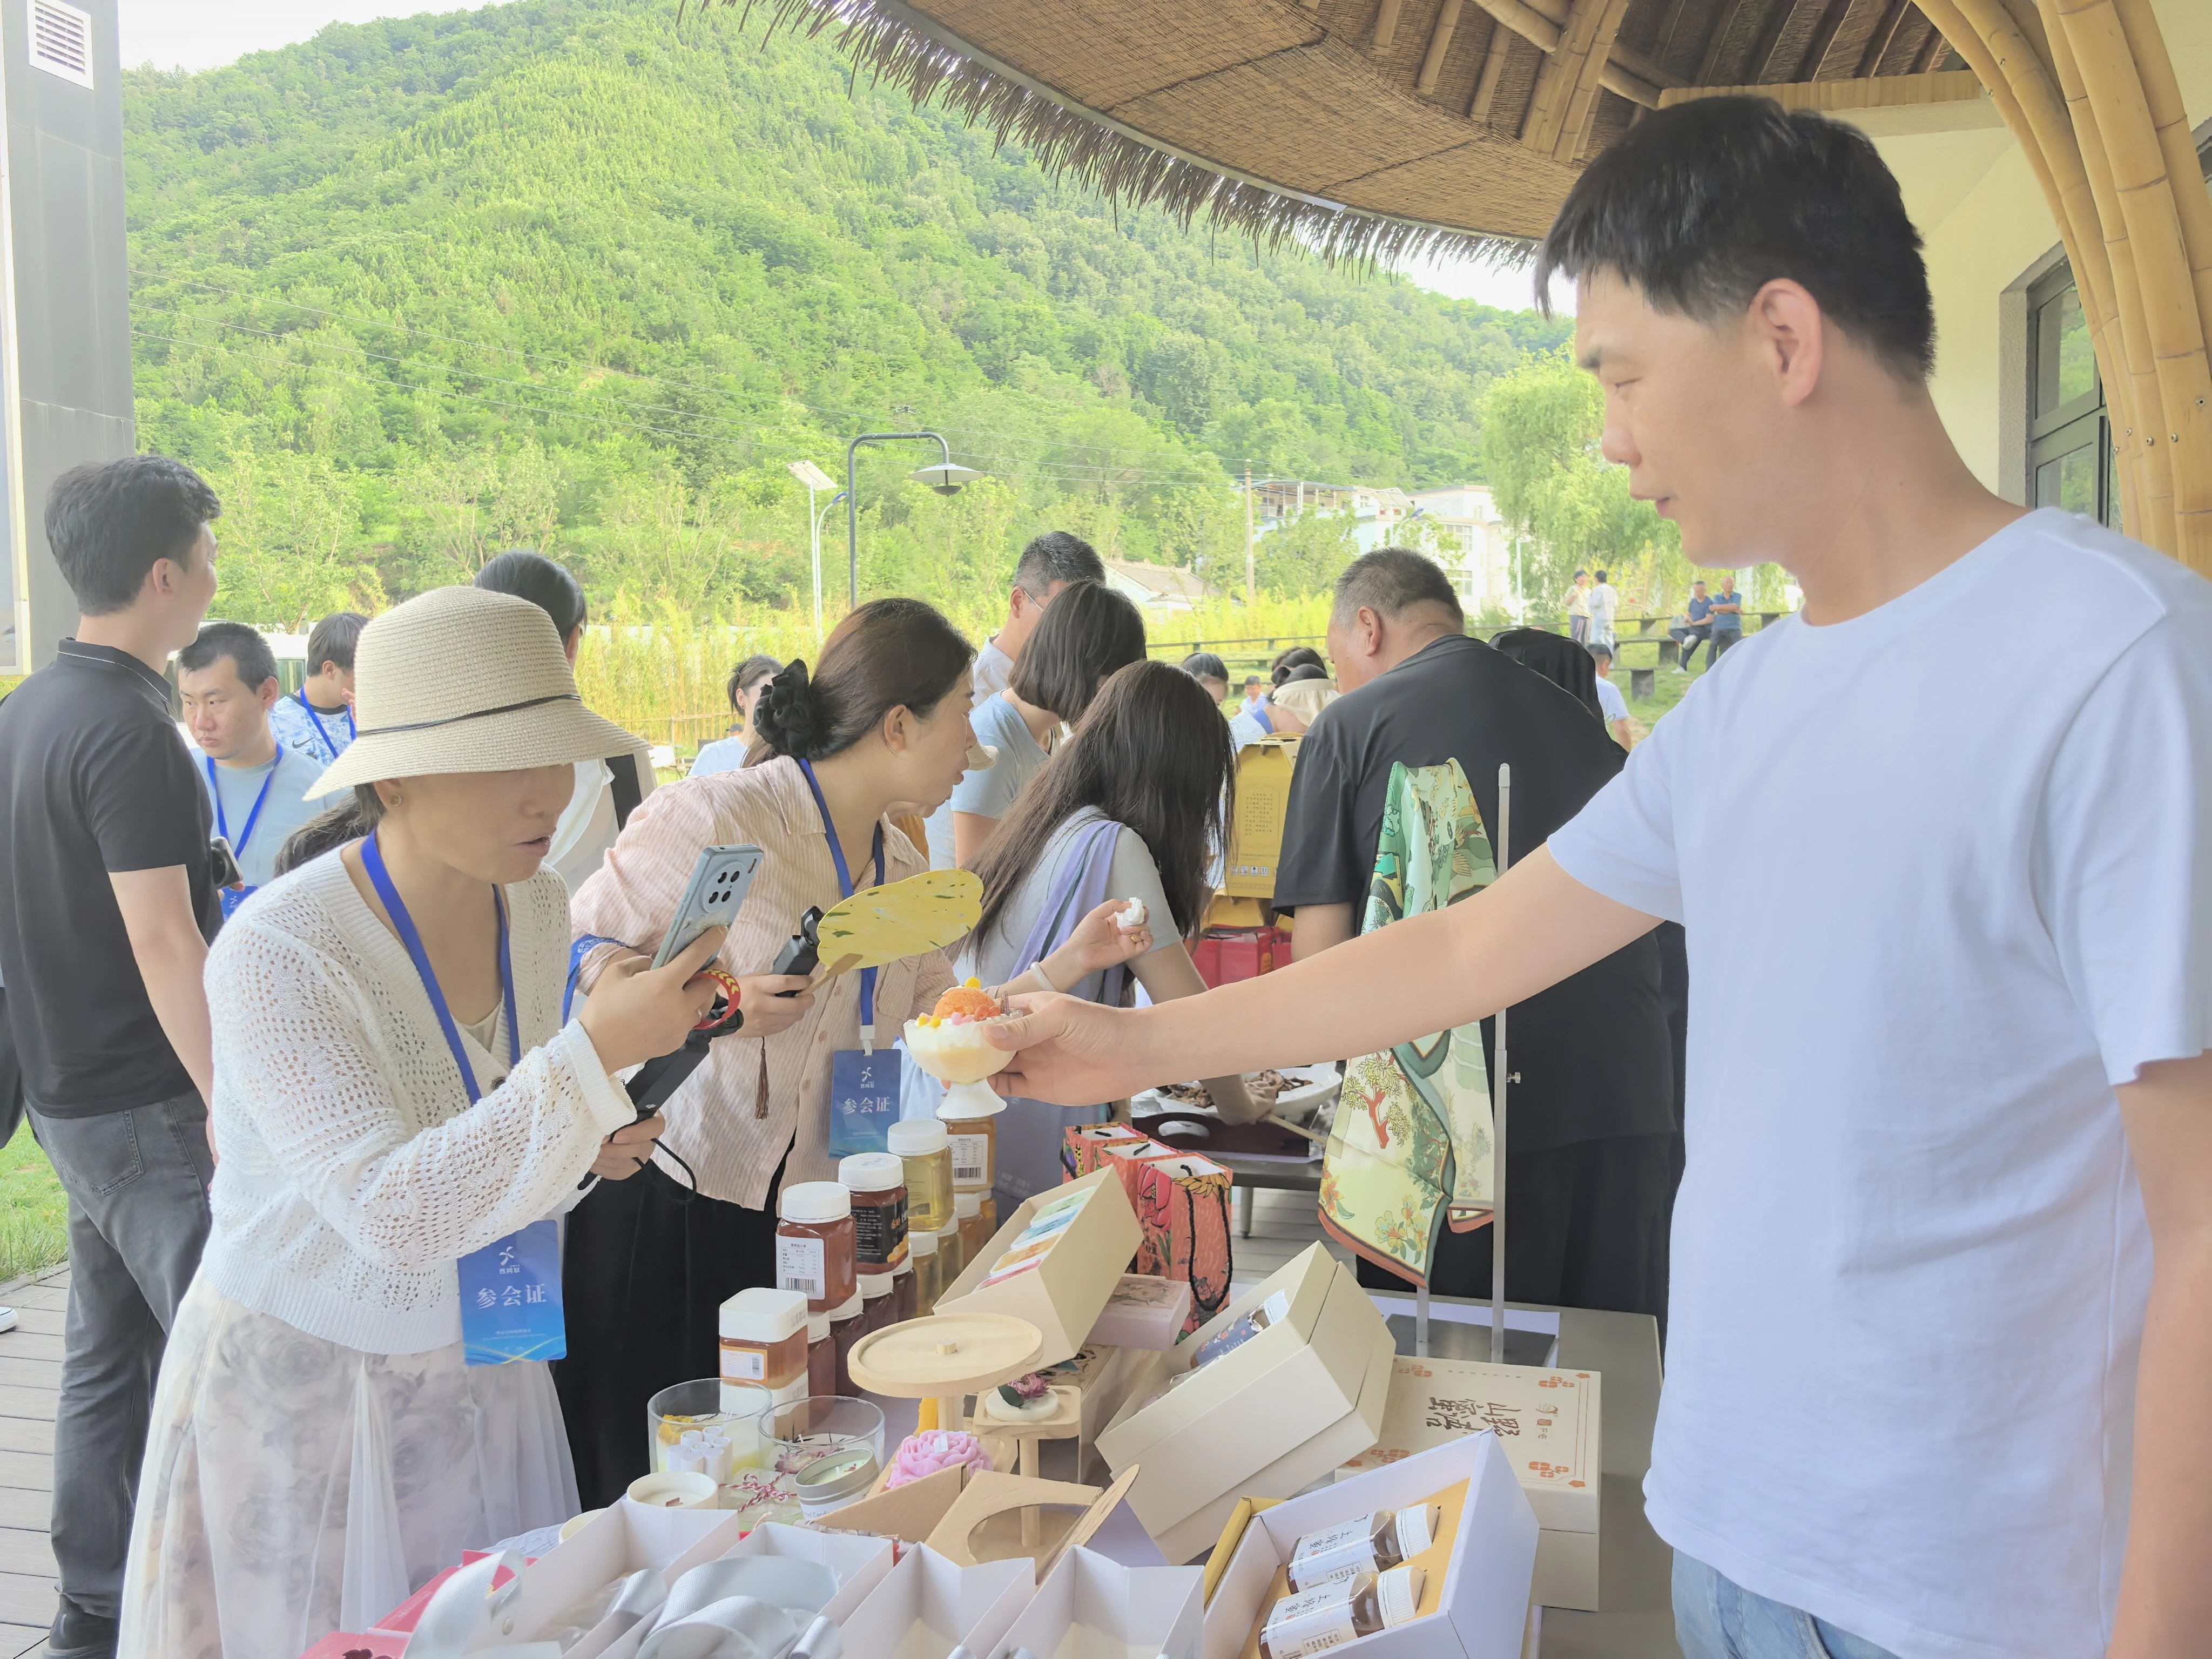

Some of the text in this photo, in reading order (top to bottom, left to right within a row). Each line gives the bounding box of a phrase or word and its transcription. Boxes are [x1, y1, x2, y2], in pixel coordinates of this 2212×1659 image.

[842, 1097, 890, 1115] 参会证
[476, 1283, 547, 1309] 参会证
